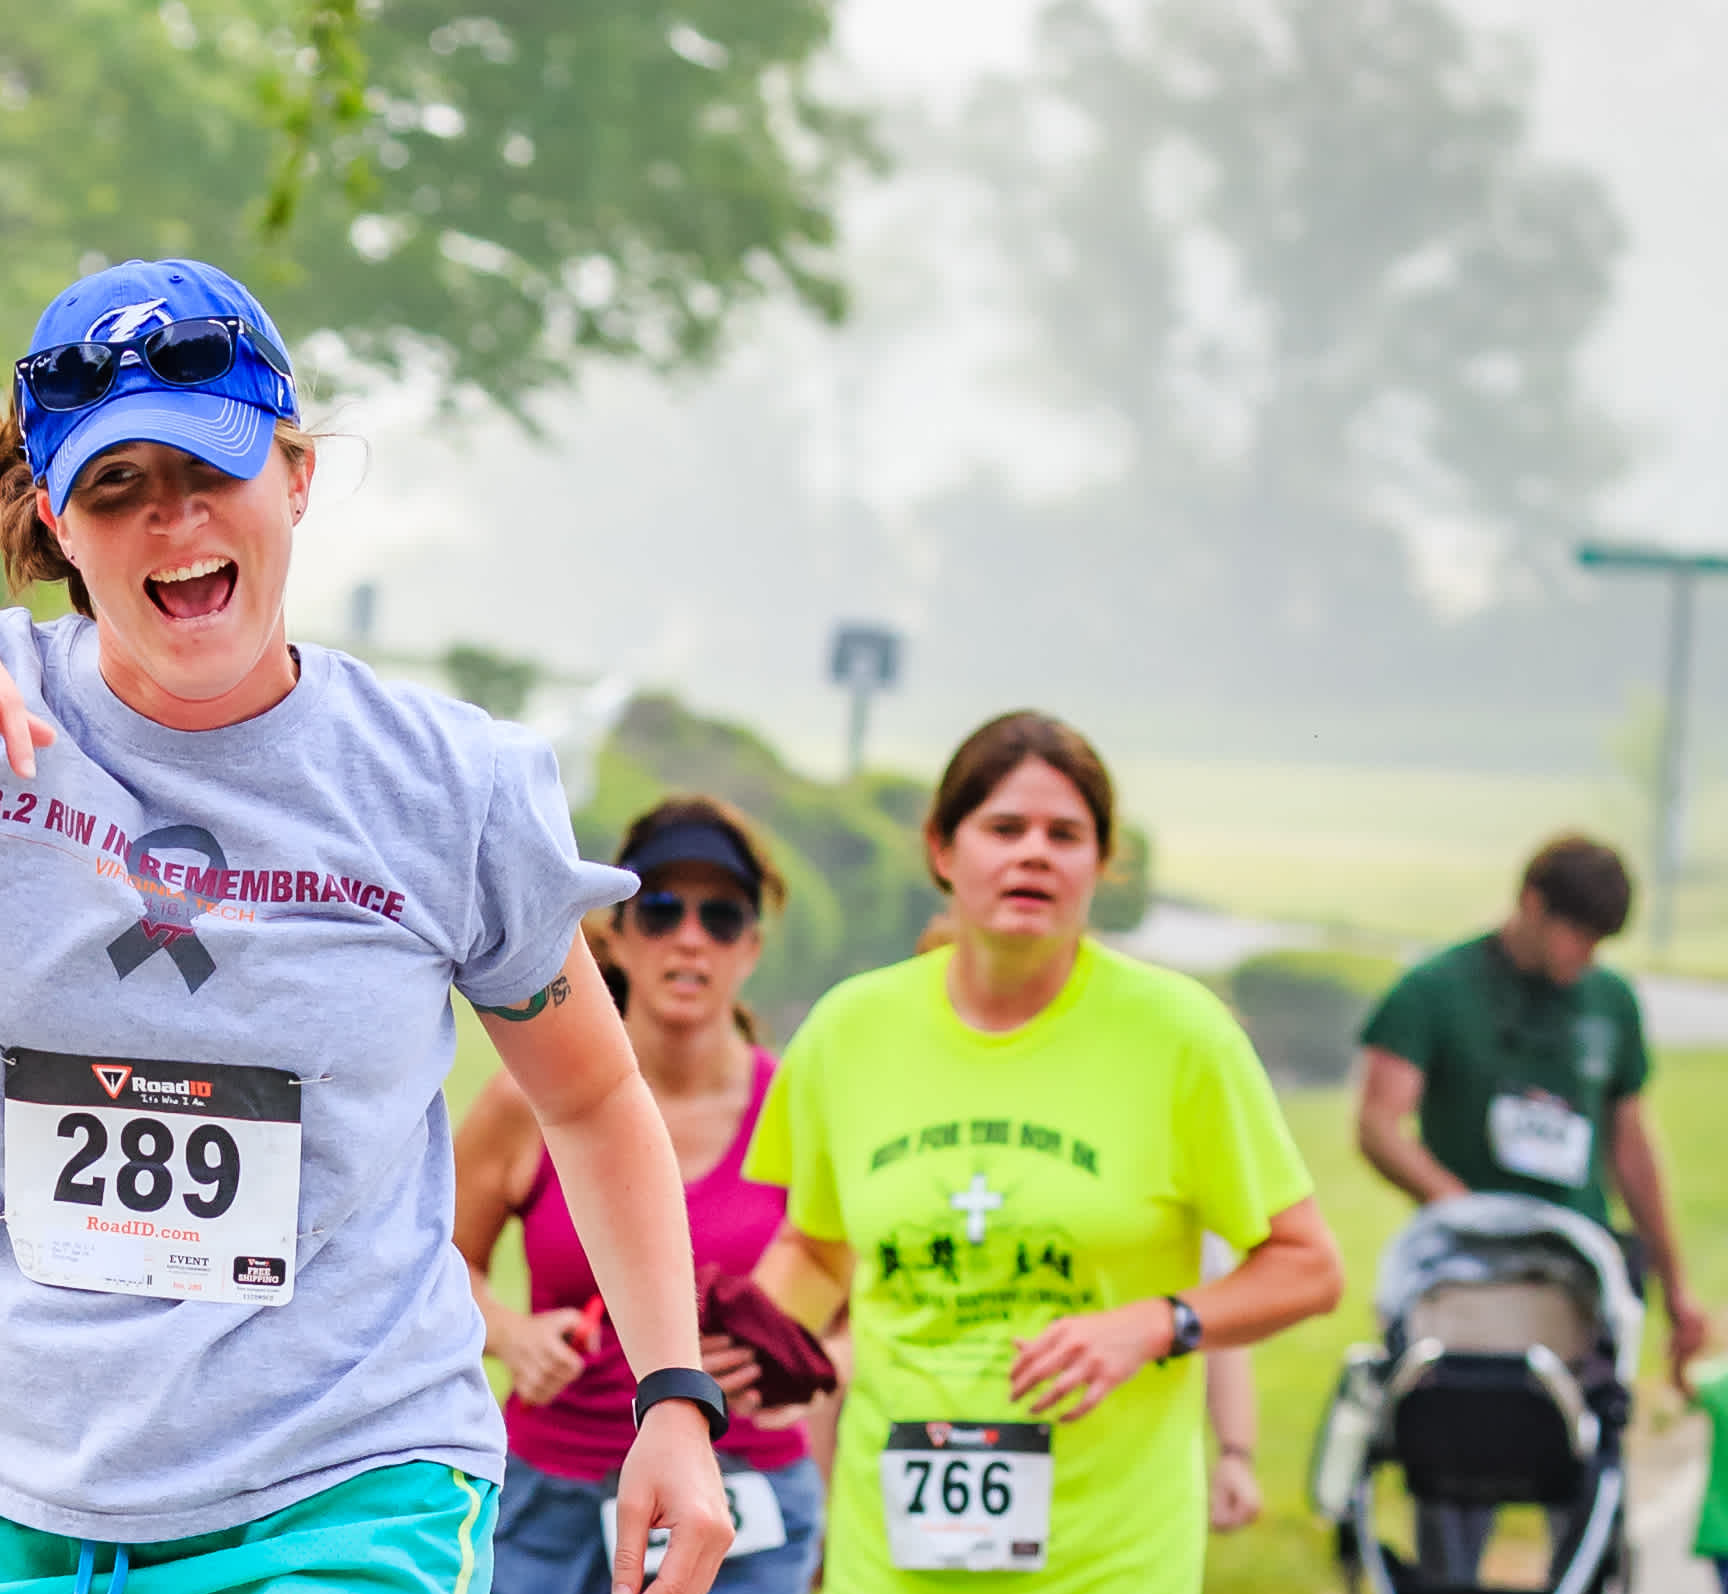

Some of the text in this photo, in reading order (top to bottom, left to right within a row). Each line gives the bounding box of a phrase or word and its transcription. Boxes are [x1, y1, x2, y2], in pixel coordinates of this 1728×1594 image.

[44, 798, 97, 846] RUN
[101, 823, 134, 866] IN
[138, 852, 405, 923] REMEMBRANCE
[96, 856, 256, 923] VIRGINIA TECH
[139, 917, 194, 947] VT
[131, 1076, 212, 1097] RoadID
[53, 1112, 240, 1219] 289
[86, 1215, 201, 1243] RoadID.com
[169, 1254, 210, 1267] EVENT
[248, 1266, 271, 1276] FREE
[904, 1460, 1012, 1516] 766
